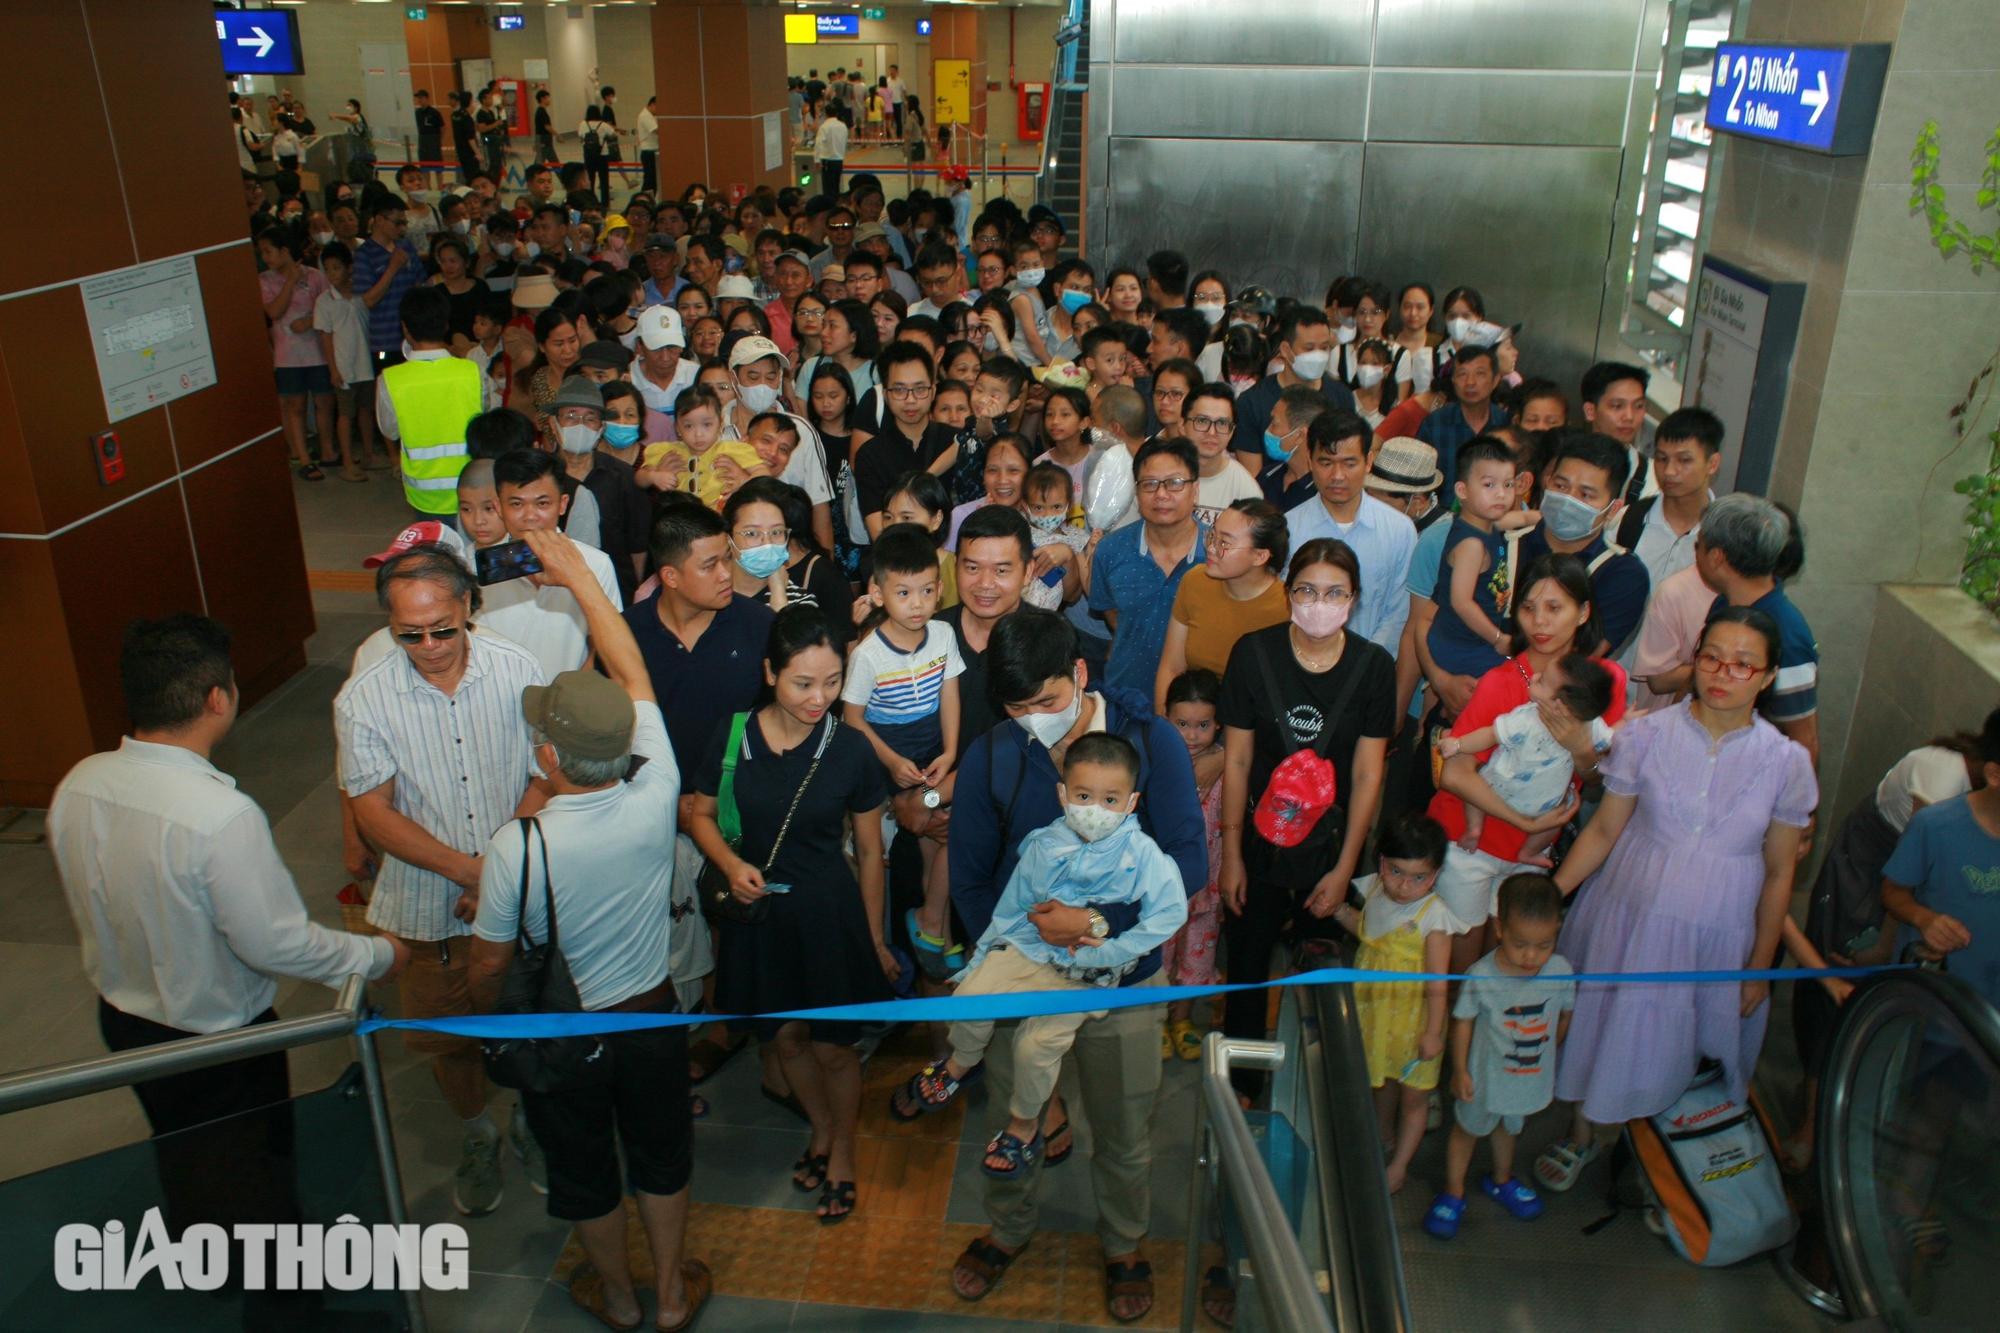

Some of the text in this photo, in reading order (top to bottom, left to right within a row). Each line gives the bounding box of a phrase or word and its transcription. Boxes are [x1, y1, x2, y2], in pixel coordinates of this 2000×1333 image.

[1763, 52, 1799, 95] Nhổn
[1725, 55, 1748, 124] 2
[1744, 100, 1779, 131] To Nhon
[397, 530, 417, 543] 03
[1686, 1100, 1737, 1125] HONDA
